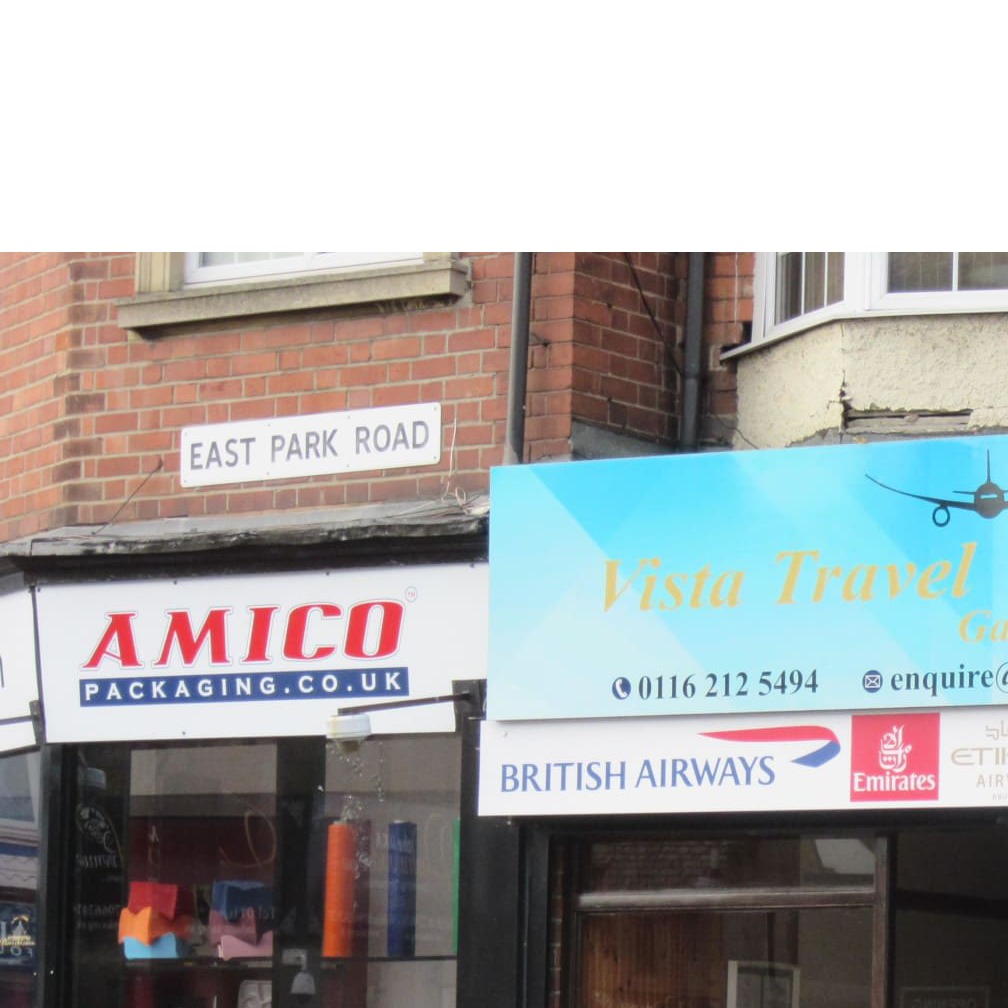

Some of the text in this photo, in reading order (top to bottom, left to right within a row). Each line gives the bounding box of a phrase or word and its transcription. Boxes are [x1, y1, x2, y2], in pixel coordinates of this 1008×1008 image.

[190, 421, 430, 470] EAST PARK ROAD
[601, 556, 746, 612] Vista
[774, 542, 977, 605] Travel
[82, 600, 404, 669] AMICO
[84, 672, 402, 701] PACKAGING.CO.UK
[638, 669, 819, 700] 0116 212 5494
[501, 755, 776, 793] BRITISH AIRWAYS
[854, 769, 936, 792] Emirates
